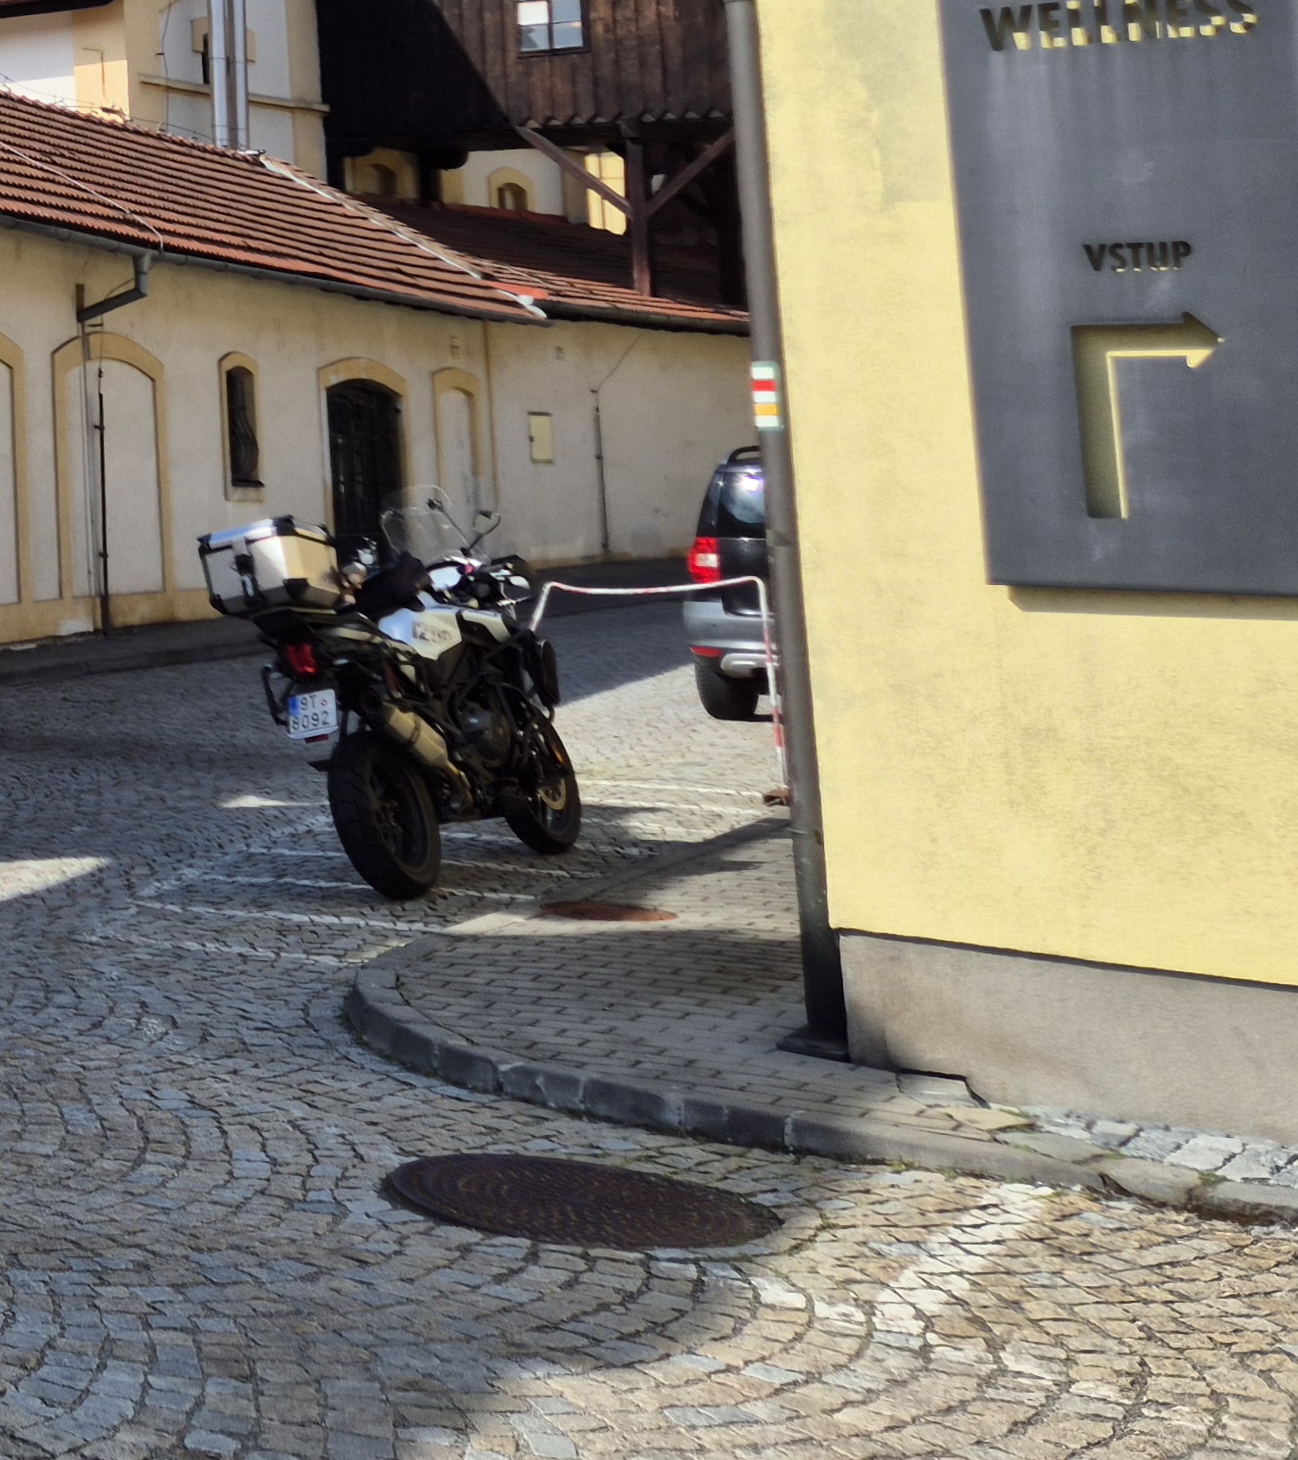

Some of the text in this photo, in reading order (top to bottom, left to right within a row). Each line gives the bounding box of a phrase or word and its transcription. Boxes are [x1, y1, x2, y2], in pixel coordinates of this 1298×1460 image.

[1082, 240, 1192, 272] VSTUP
[299, 695, 317, 712] 9T
[291, 710, 331, 731] 8092
